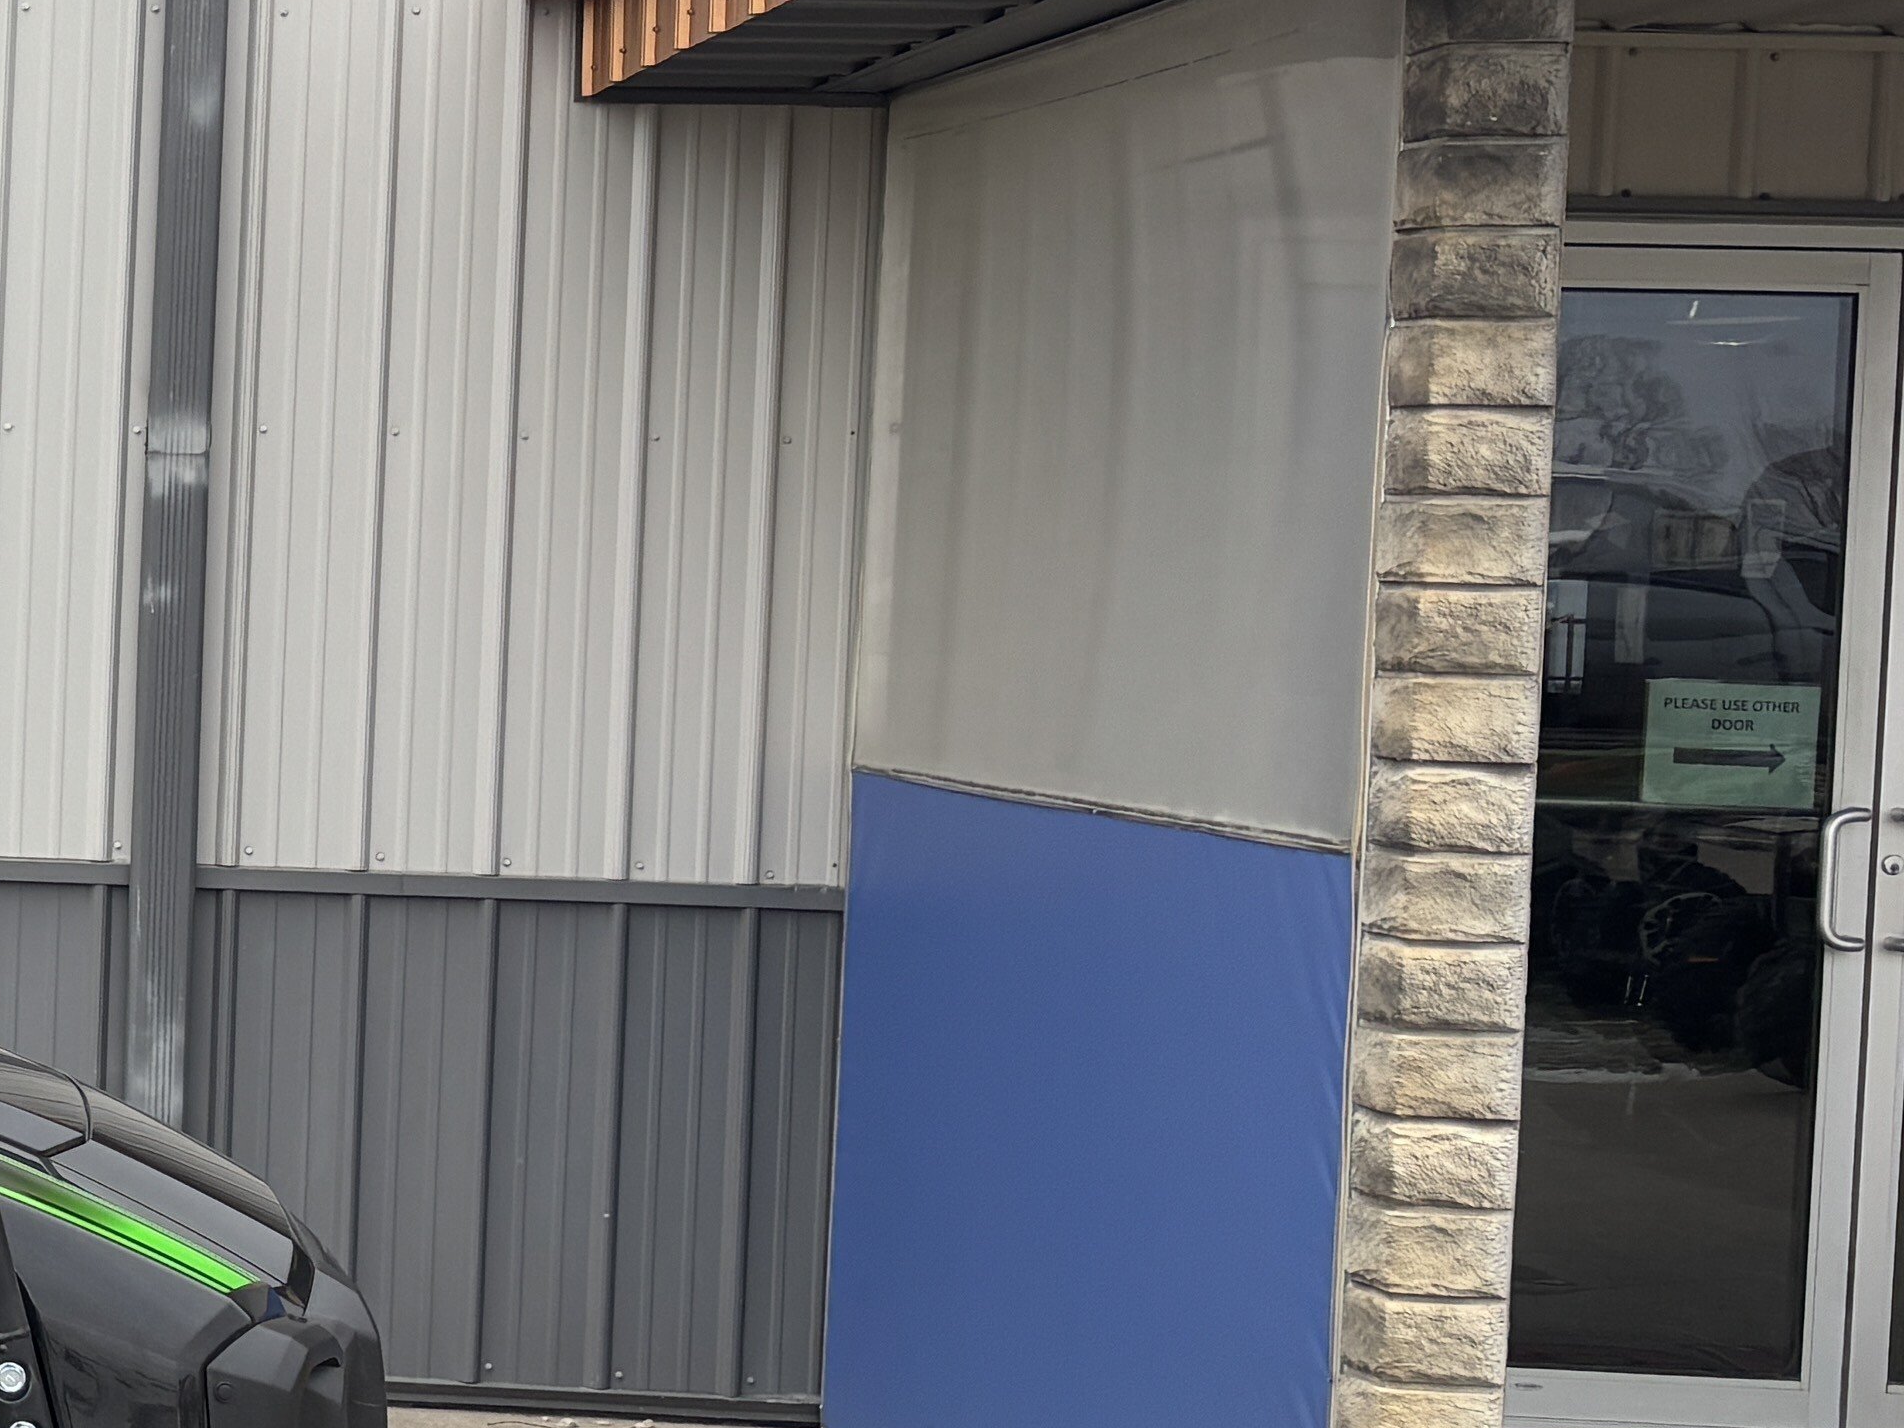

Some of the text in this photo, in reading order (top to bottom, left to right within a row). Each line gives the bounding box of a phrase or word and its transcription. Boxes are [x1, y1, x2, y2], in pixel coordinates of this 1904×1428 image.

[1663, 696, 1801, 714] PLEASE USE OTHER
[1711, 718, 1755, 732] DOOR
